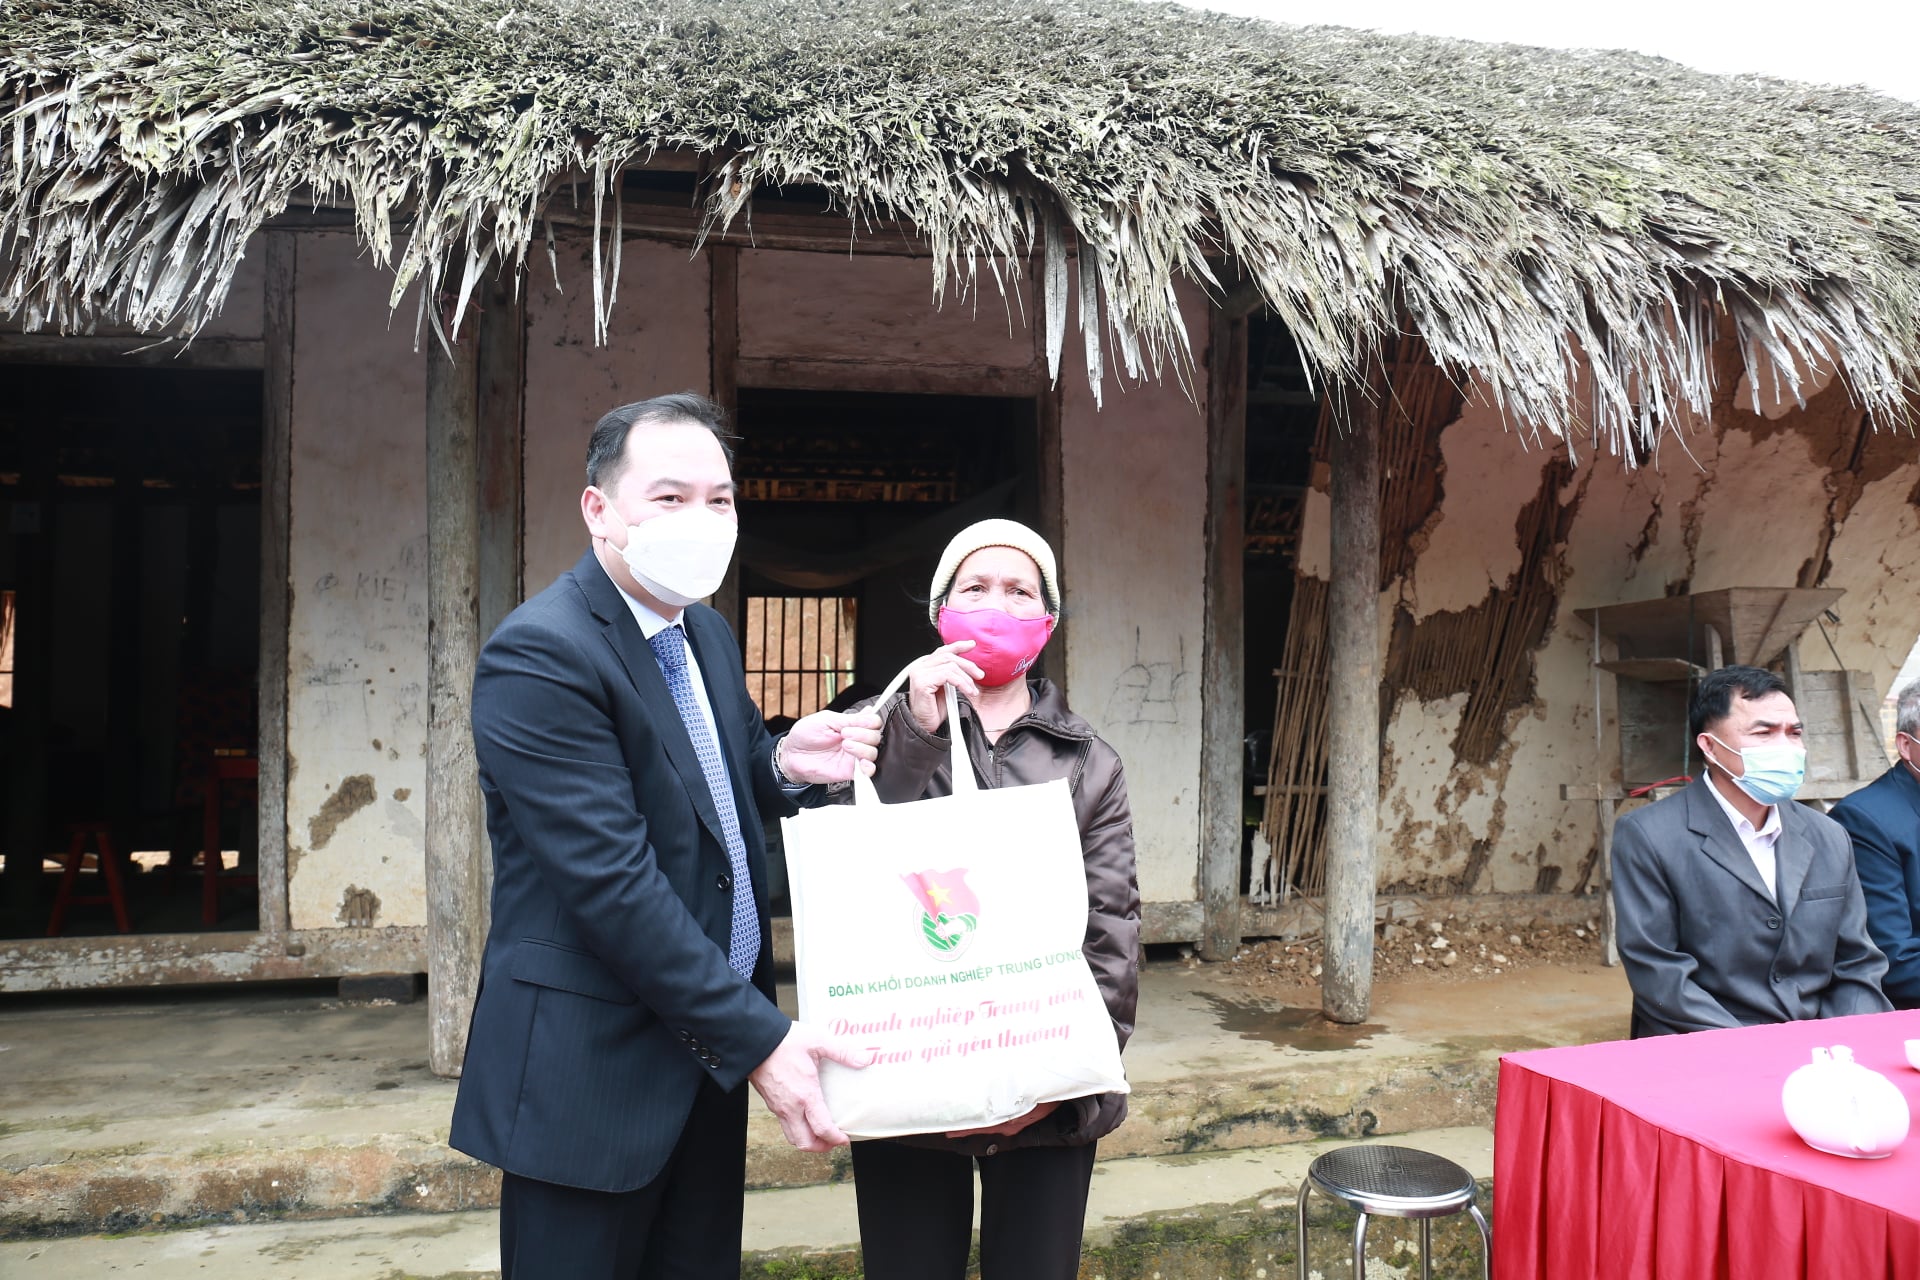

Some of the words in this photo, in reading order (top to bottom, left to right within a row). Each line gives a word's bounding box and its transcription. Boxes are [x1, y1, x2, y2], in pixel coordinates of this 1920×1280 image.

[829, 981, 863, 998] ĐOÀN
[905, 974, 947, 989] DOANH
[950, 965, 993, 984] NGHIỆP
[997, 958, 1042, 976] TRUNG
[828, 1012, 903, 1036] Doanh
[979, 999, 1040, 1018] Trung
[865, 1046, 912, 1066] Trao
[957, 1035, 992, 1057] yêu
